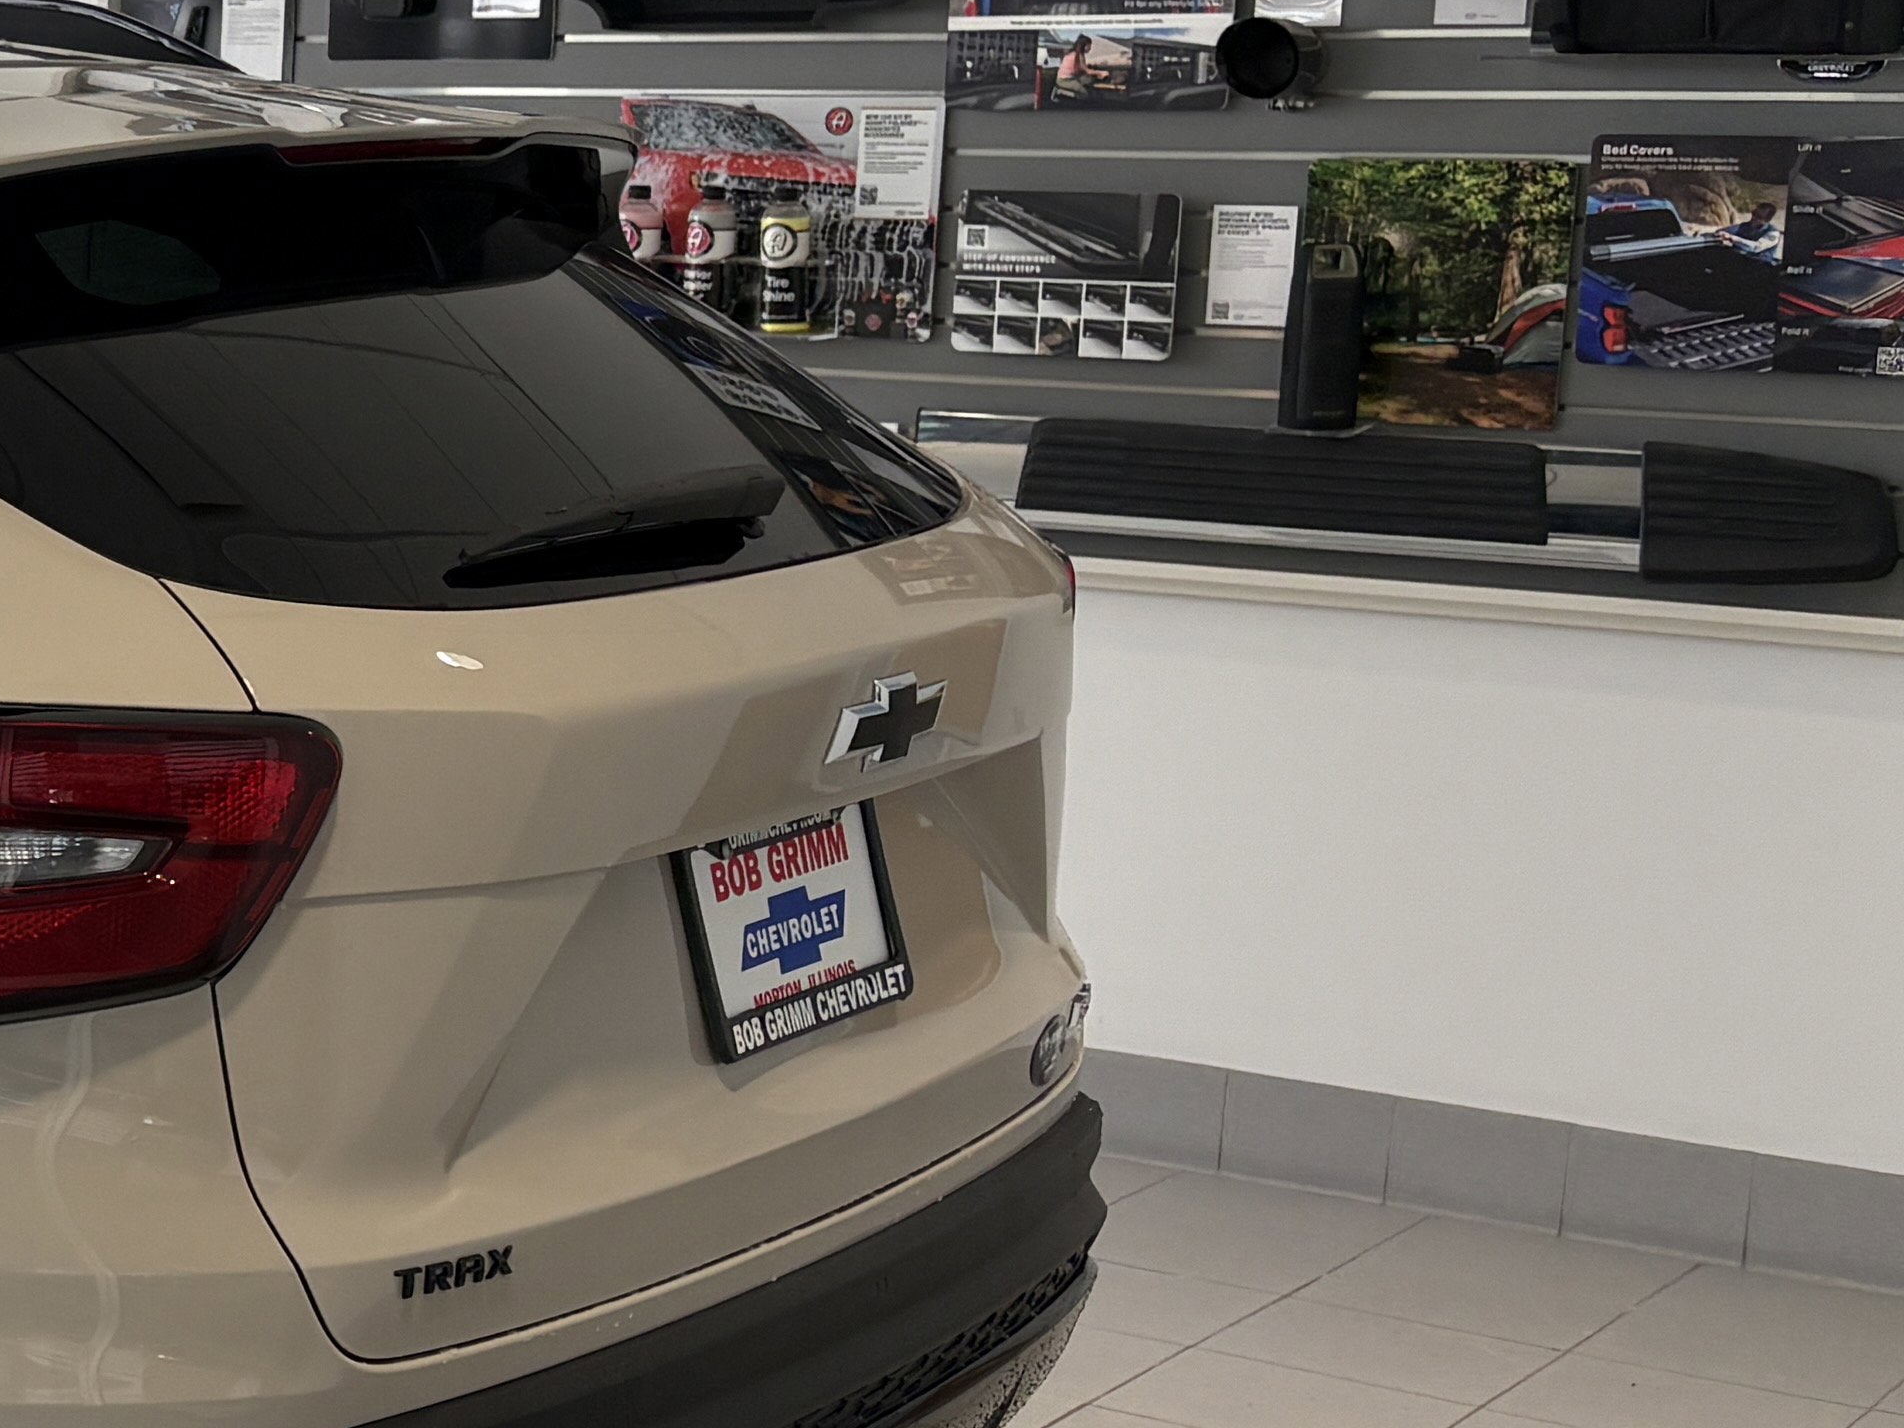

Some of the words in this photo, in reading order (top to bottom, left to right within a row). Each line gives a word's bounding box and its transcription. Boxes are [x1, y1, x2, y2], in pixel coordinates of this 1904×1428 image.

[1602, 144, 1628, 155] Bed
[1630, 144, 1674, 156] Covers
[763, 291, 796, 303] Shine
[765, 275, 789, 288] Tire
[710, 851, 763, 903] BOB
[767, 822, 850, 883] GRIMM
[746, 904, 839, 958] CHEVROLET
[733, 1017, 765, 1054] BOB
[765, 998, 817, 1040] GRIMM
[816, 964, 907, 1021] CHEVROLET
[394, 1245, 513, 1300] TRAX
